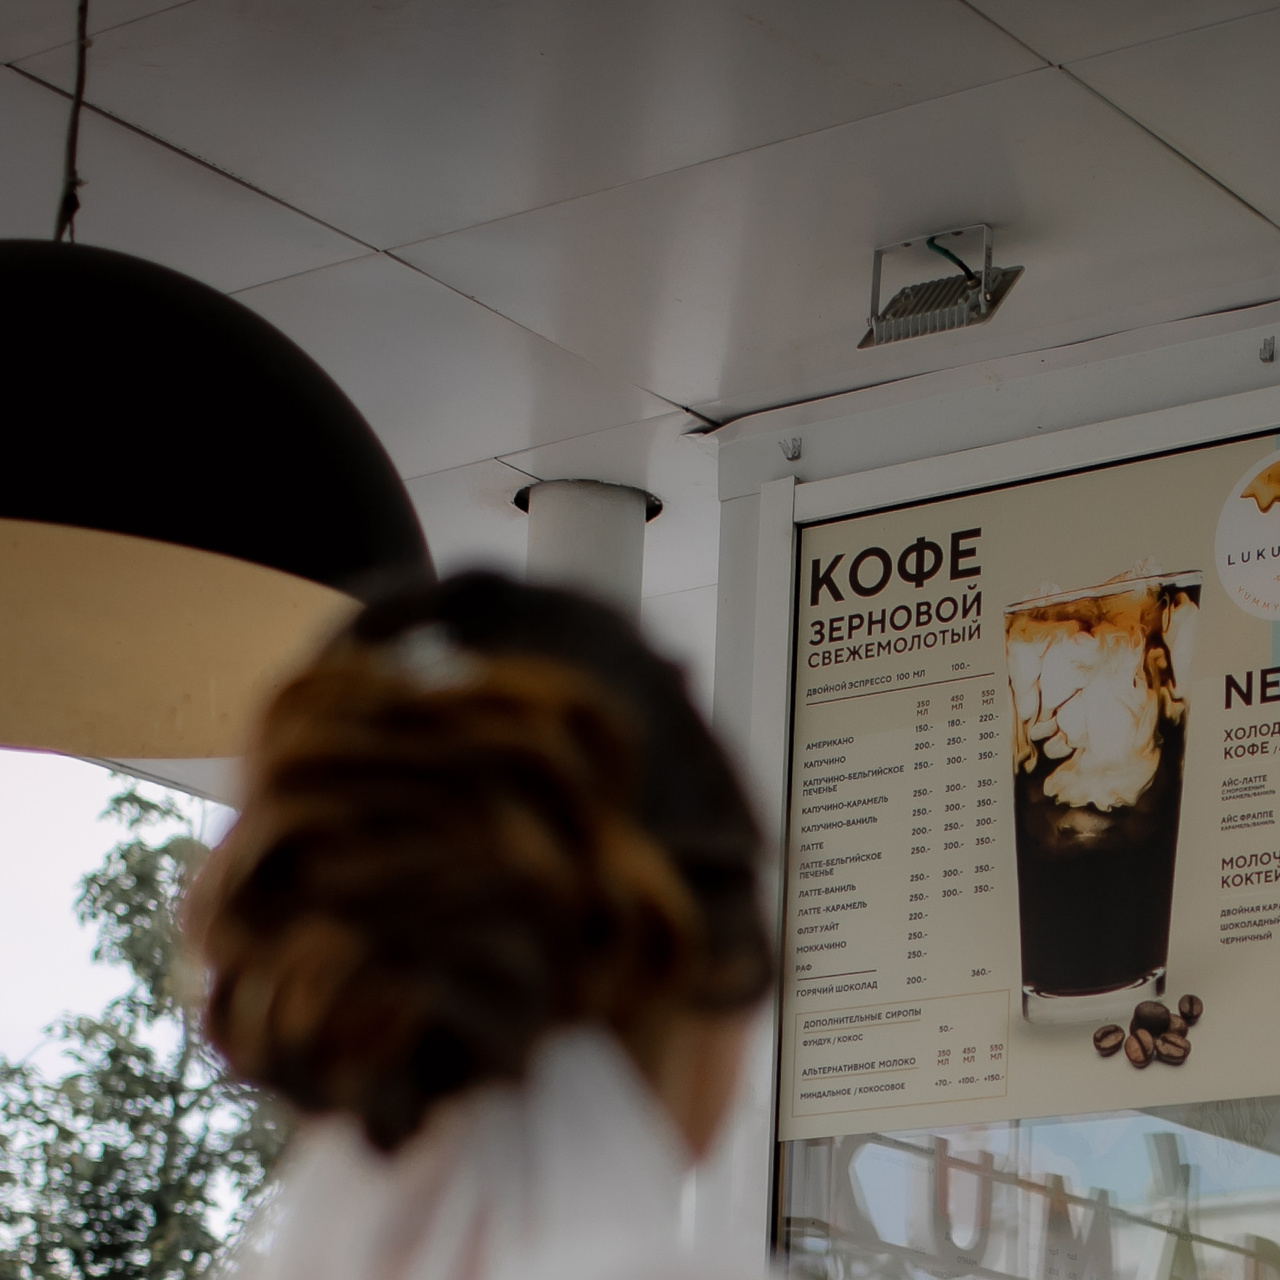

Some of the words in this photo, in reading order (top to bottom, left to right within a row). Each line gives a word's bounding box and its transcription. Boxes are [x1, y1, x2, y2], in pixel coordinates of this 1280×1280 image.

[810, 527, 982, 607] КОФЕ
[1237, 586, 1280, 611] YUMMY
[808, 583, 982, 646] ЗЕРНОВОЙ
[807, 620, 981, 668] СВЕЖЕМОЛОТЫЙ
[806, 681, 847, 698] ДВОЙНОЙ
[848, 674, 892, 690] ЭСПРЕССО
[896, 672, 910, 682] 100
[912, 669, 926, 680] МЛ
[916, 700, 931, 708] 350
[950, 694, 965, 702] 450
[981, 689, 995, 698] 550
[916, 708, 929, 716] МЛ
[951, 702, 963, 711] МЛ
[982, 698, 994, 706] МЛ
[806, 736, 855, 751] АМЕРИКАНО
[1224, 741, 1269, 760] КОФЕ
[804, 756, 847, 769] КАПУЧИНО
[803, 765, 904, 788] КАПУЧИНО-БЕЛЬГИЙСКОЕ
[1222, 774, 1267, 788] АЙС-ЛАТТЕ
[803, 785, 838, 797] ПЕЧЕНЬЕ
[802, 796, 889, 815] КАПУЧИНО-КАРАМЕЛЬ
[801, 815, 878, 834] КАПУЧИНО-ВАНИЛЬ
[1221, 814, 1238, 824] АЙС
[1240, 810, 1273, 821] ФРАППЕ
[800, 842, 824, 853] ЛАТТЕ
[799, 852, 882, 871] ЛАТТЕ-БЕЛЬГИЙСКОЕ
[799, 868, 834, 880] ПЕЧЕНЬЕ
[798, 883, 857, 898] ЛАТТЕ-ВАНИЛЬ
[1220, 905, 1260, 918] ДВОЙНАЯ
[797, 925, 819, 936] ФЛЭТ
[819, 922, 840, 933] УАЙТ
[1220, 931, 1272, 945] ЧЕРНИЧНЫЙ
[796, 940, 847, 954] МОККАЧИНО
[796, 963, 813, 973] РАФ
[796, 985, 834, 998] ГОРЯЧИЙ
[835, 980, 878, 994] ШОКОЛАД
[803, 1012, 882, 1030] ДОПОЛНИТЕЛЬНЫЕ
[885, 1008, 922, 1020] СИРОПЫ
[802, 1036, 832, 1047] ФУНДУК
[837, 1033, 864, 1043] КОКОС
[938, 1050, 951, 1058] 350
[962, 1047, 976, 1055] 450
[990, 1044, 1003, 1052] 550
[802, 1061, 876, 1077] АЛЬТЕРНАТИВНОЕ
[878, 1057, 916, 1069] МОЛОКО
[937, 1058, 949, 1066] МЛ
[963, 1056, 975, 1064] МЛ
[990, 1053, 1002, 1061] МЛ
[800, 1087, 851, 1100] МИНДАЛЬНОЕ
